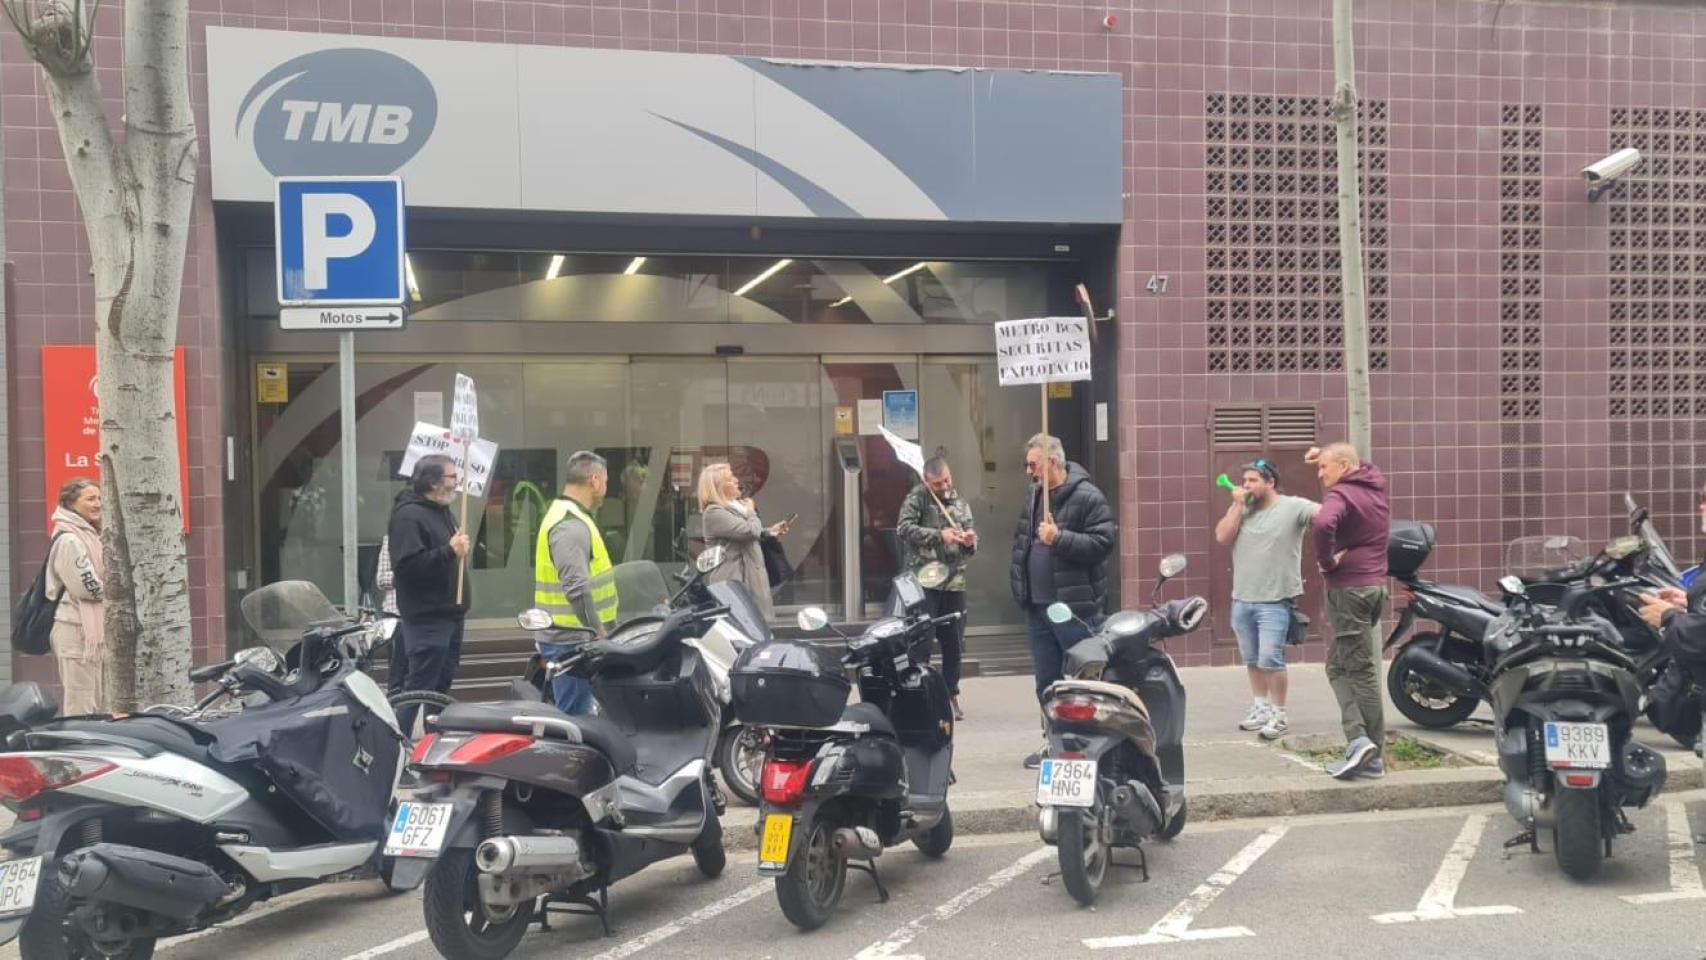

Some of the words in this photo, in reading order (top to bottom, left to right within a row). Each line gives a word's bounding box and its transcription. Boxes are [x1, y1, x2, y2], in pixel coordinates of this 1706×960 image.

[281, 99, 413, 145] TMB
[301, 193, 376, 290] P
[1146, 274, 1169, 294] 47
[319, 312, 363, 325] Motos
[999, 323, 1050, 338] METRO
[1056, 322, 1083, 334] BCN
[999, 340, 1082, 357] SECURITAS
[414, 435, 450, 451] STOP
[65, 452, 89, 467] La
[1561, 725, 1604, 743] 9389
[1568, 743, 1599, 759] KKV
[1053, 762, 1092, 780] 7964
[1052, 779, 1081, 797] HNG
[408, 806, 446, 826] 6061
[401, 825, 433, 847] GFZ
[1, 861, 36, 883] 7964
